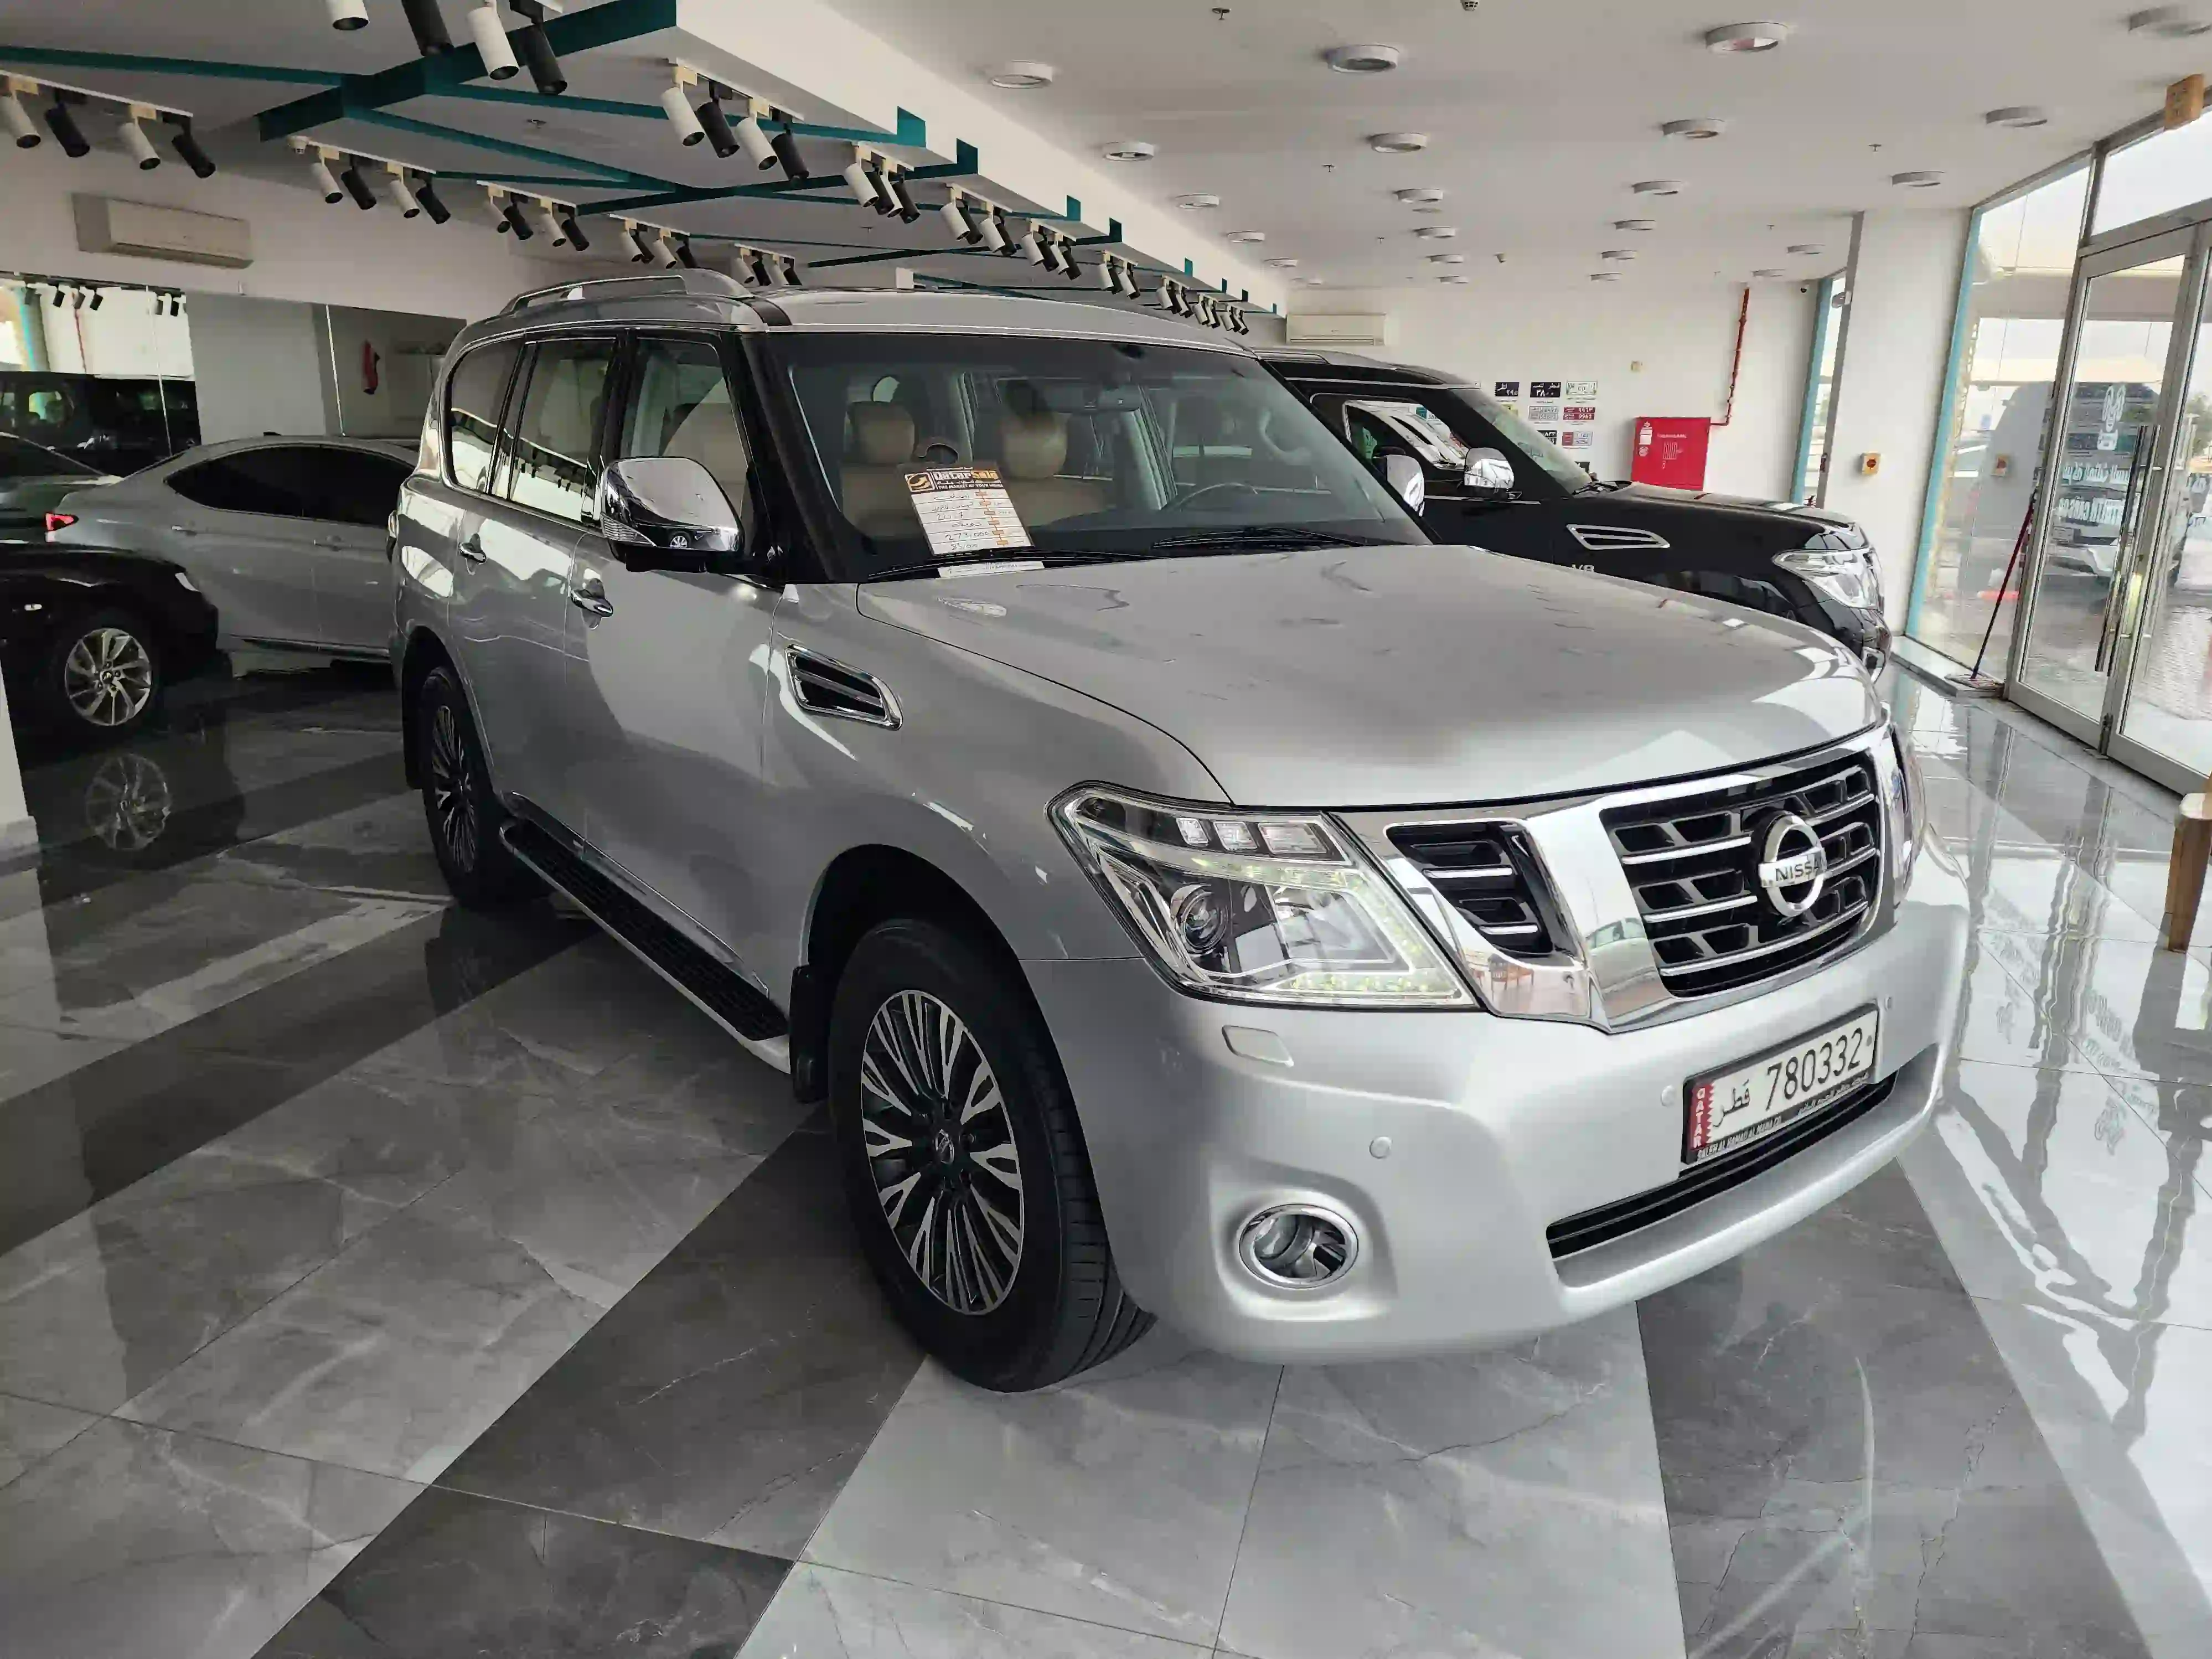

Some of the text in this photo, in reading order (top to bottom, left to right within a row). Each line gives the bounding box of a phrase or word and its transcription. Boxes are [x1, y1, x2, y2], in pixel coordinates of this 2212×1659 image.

[1765, 1027, 1862, 1111] 780332
[1694, 1088, 1705, 1148] QATAR
[1713, 1078, 1750, 1128] قطر
